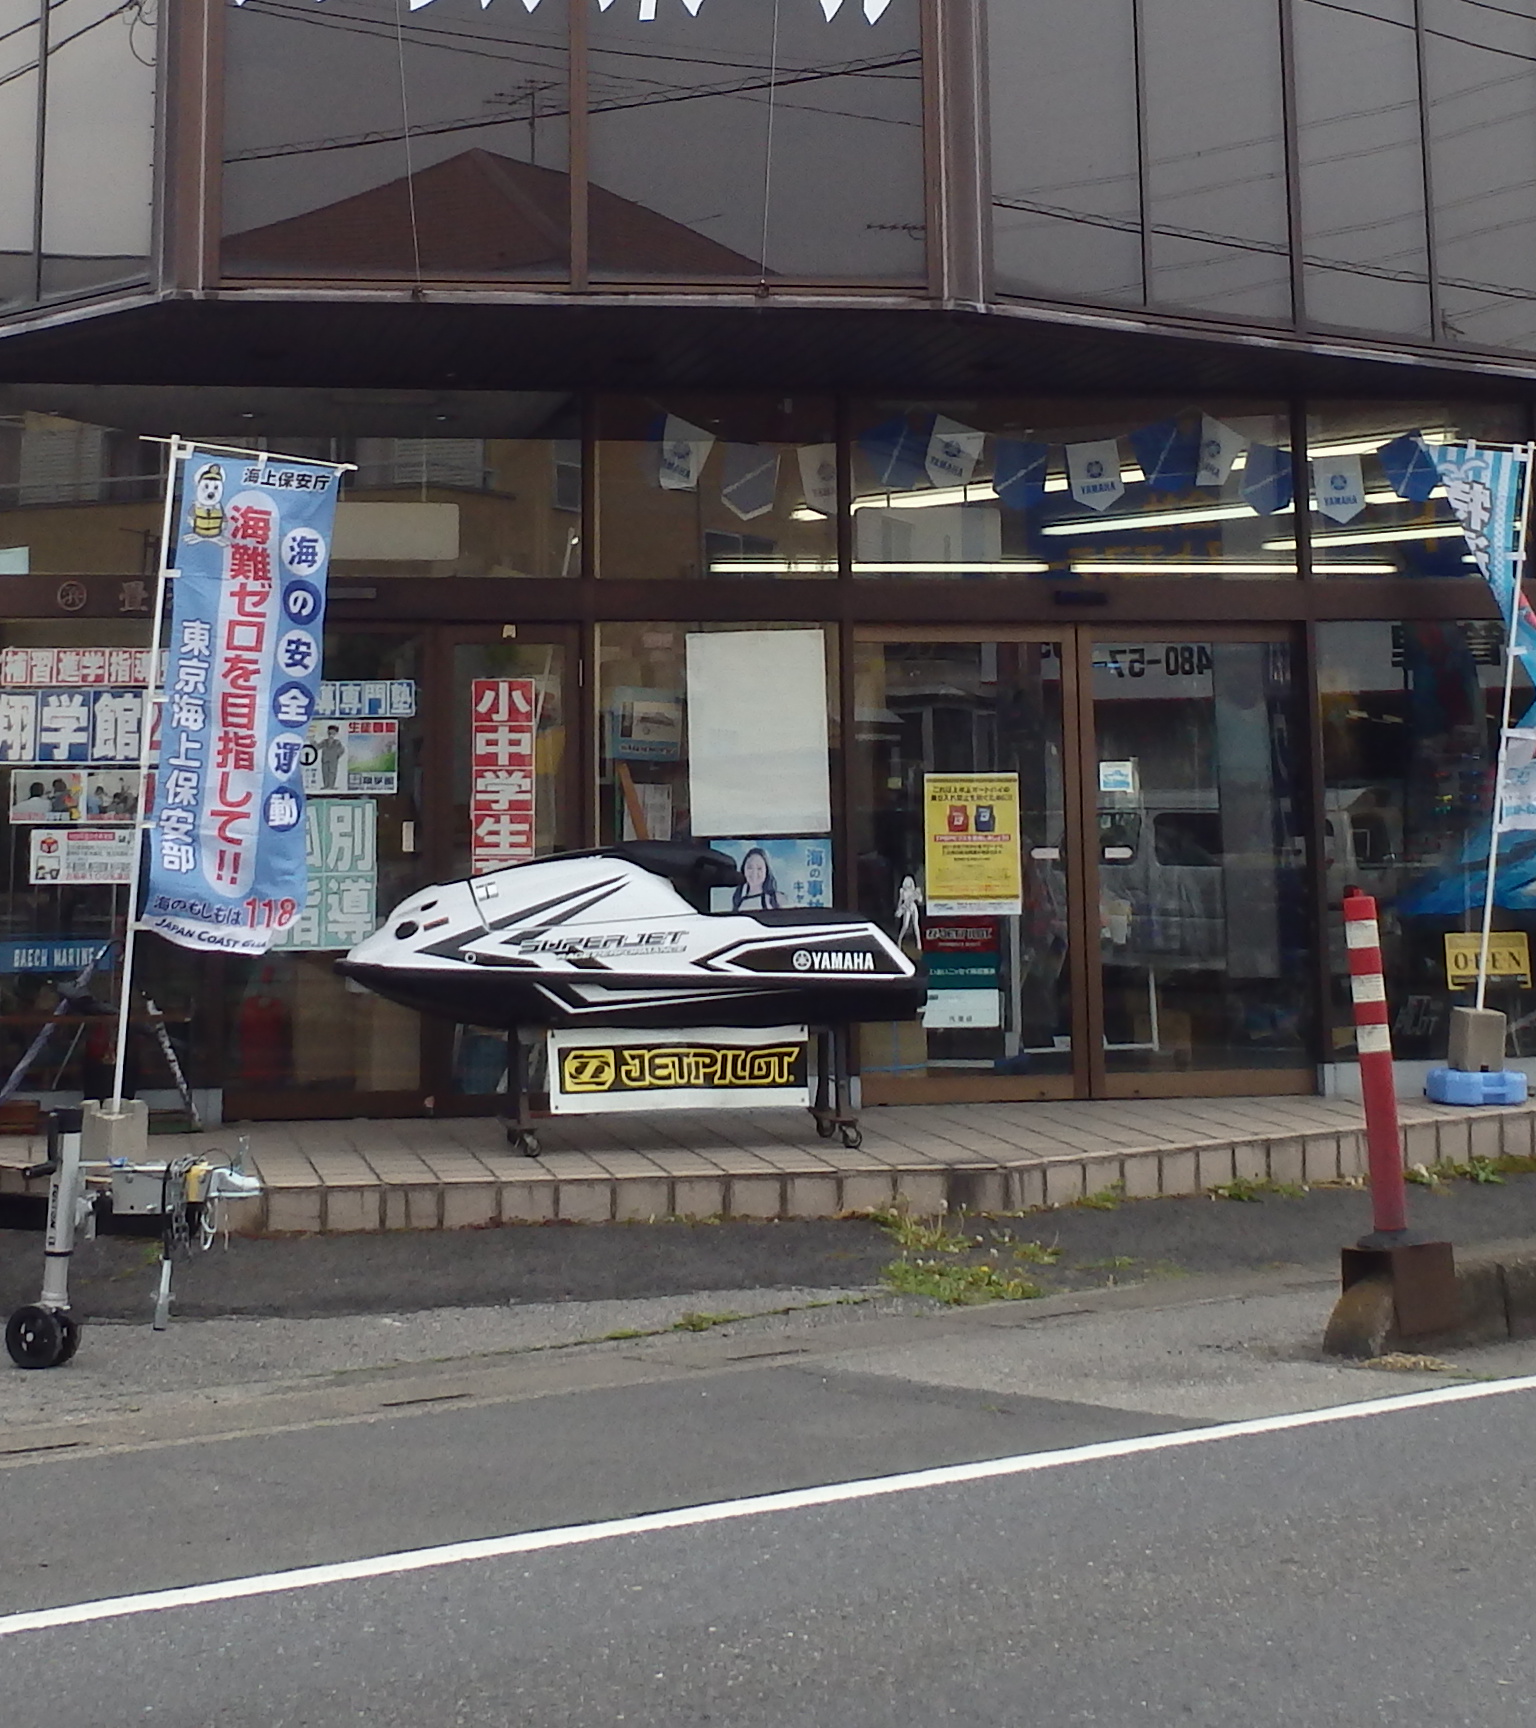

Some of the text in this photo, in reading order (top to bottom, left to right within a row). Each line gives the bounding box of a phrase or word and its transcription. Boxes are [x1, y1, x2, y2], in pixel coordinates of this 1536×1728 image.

[1080, 478, 1117, 497] YAMAHA
[1323, 493, 1358, 507] YAMAHA
[159, 619, 212, 874] 東京海上保安部
[475, 681, 532, 872] 小中学生
[244, 896, 297, 930] 118
[155, 917, 195, 938] JAPAN
[197, 930, 240, 949] COAST
[811, 951, 875, 971] YAMAHA
[621, 1046, 800, 1087] JETPILOT
